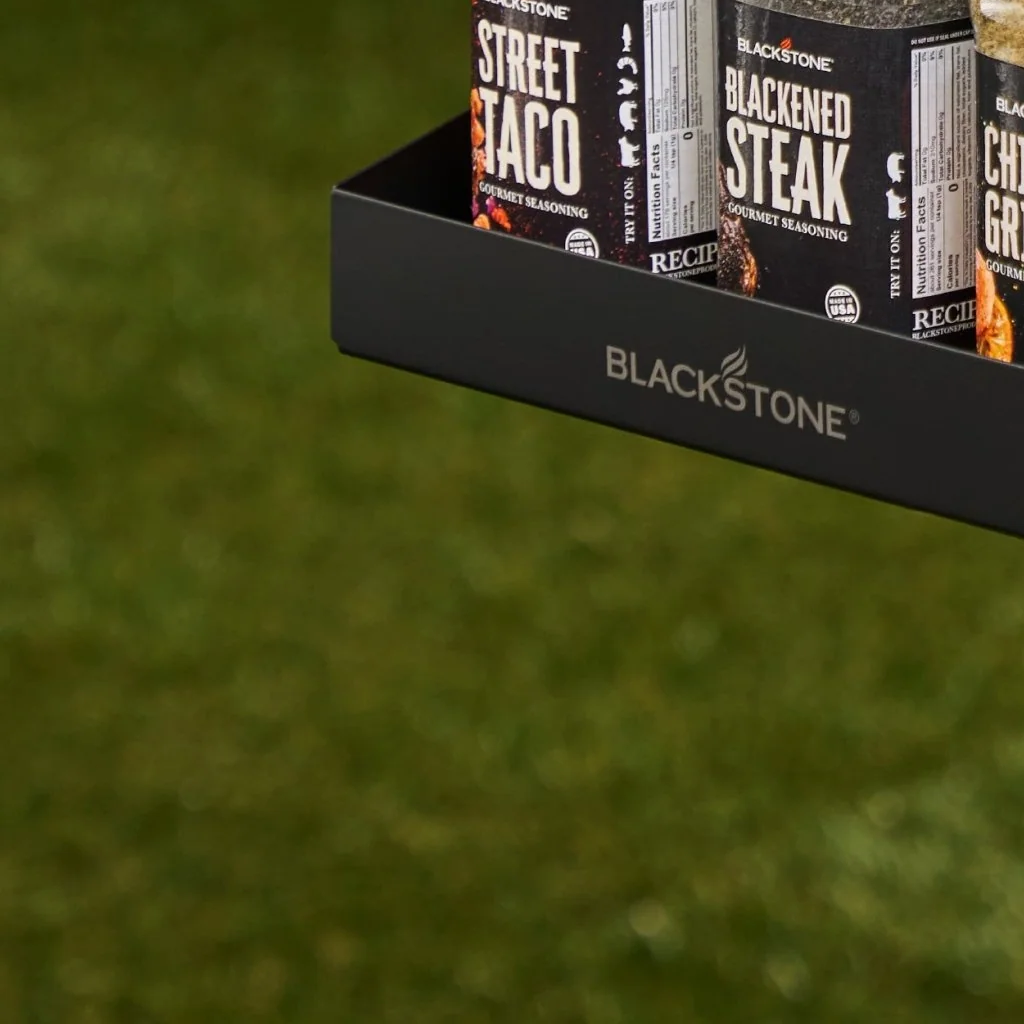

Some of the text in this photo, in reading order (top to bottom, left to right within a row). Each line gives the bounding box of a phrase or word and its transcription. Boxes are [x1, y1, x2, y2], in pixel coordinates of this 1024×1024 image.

[477, 18, 580, 104] STREET
[737, 37, 832, 72] BLACKSTONE
[725, 66, 851, 139] BLACKENED
[480, 86, 581, 196] TACO
[683, 132, 693, 140] 0
[726, 116, 851, 225] STEAK
[948, 184, 958, 192] 0
[479, 180, 588, 219] GOURMET SEASONING
[624, 176, 635, 244] TRY IT ON:
[651, 144, 662, 239] Nutrition Facts
[727, 202, 848, 242] GOURMET SEASONING
[916, 197, 926, 232] Facts
[649, 243, 718, 273] RECIP
[890, 229, 900, 299] TRY IT ON:
[917, 237, 926, 294] Nutrition
[830, 304, 856, 316] USA
[913, 300, 976, 331] RECIP
